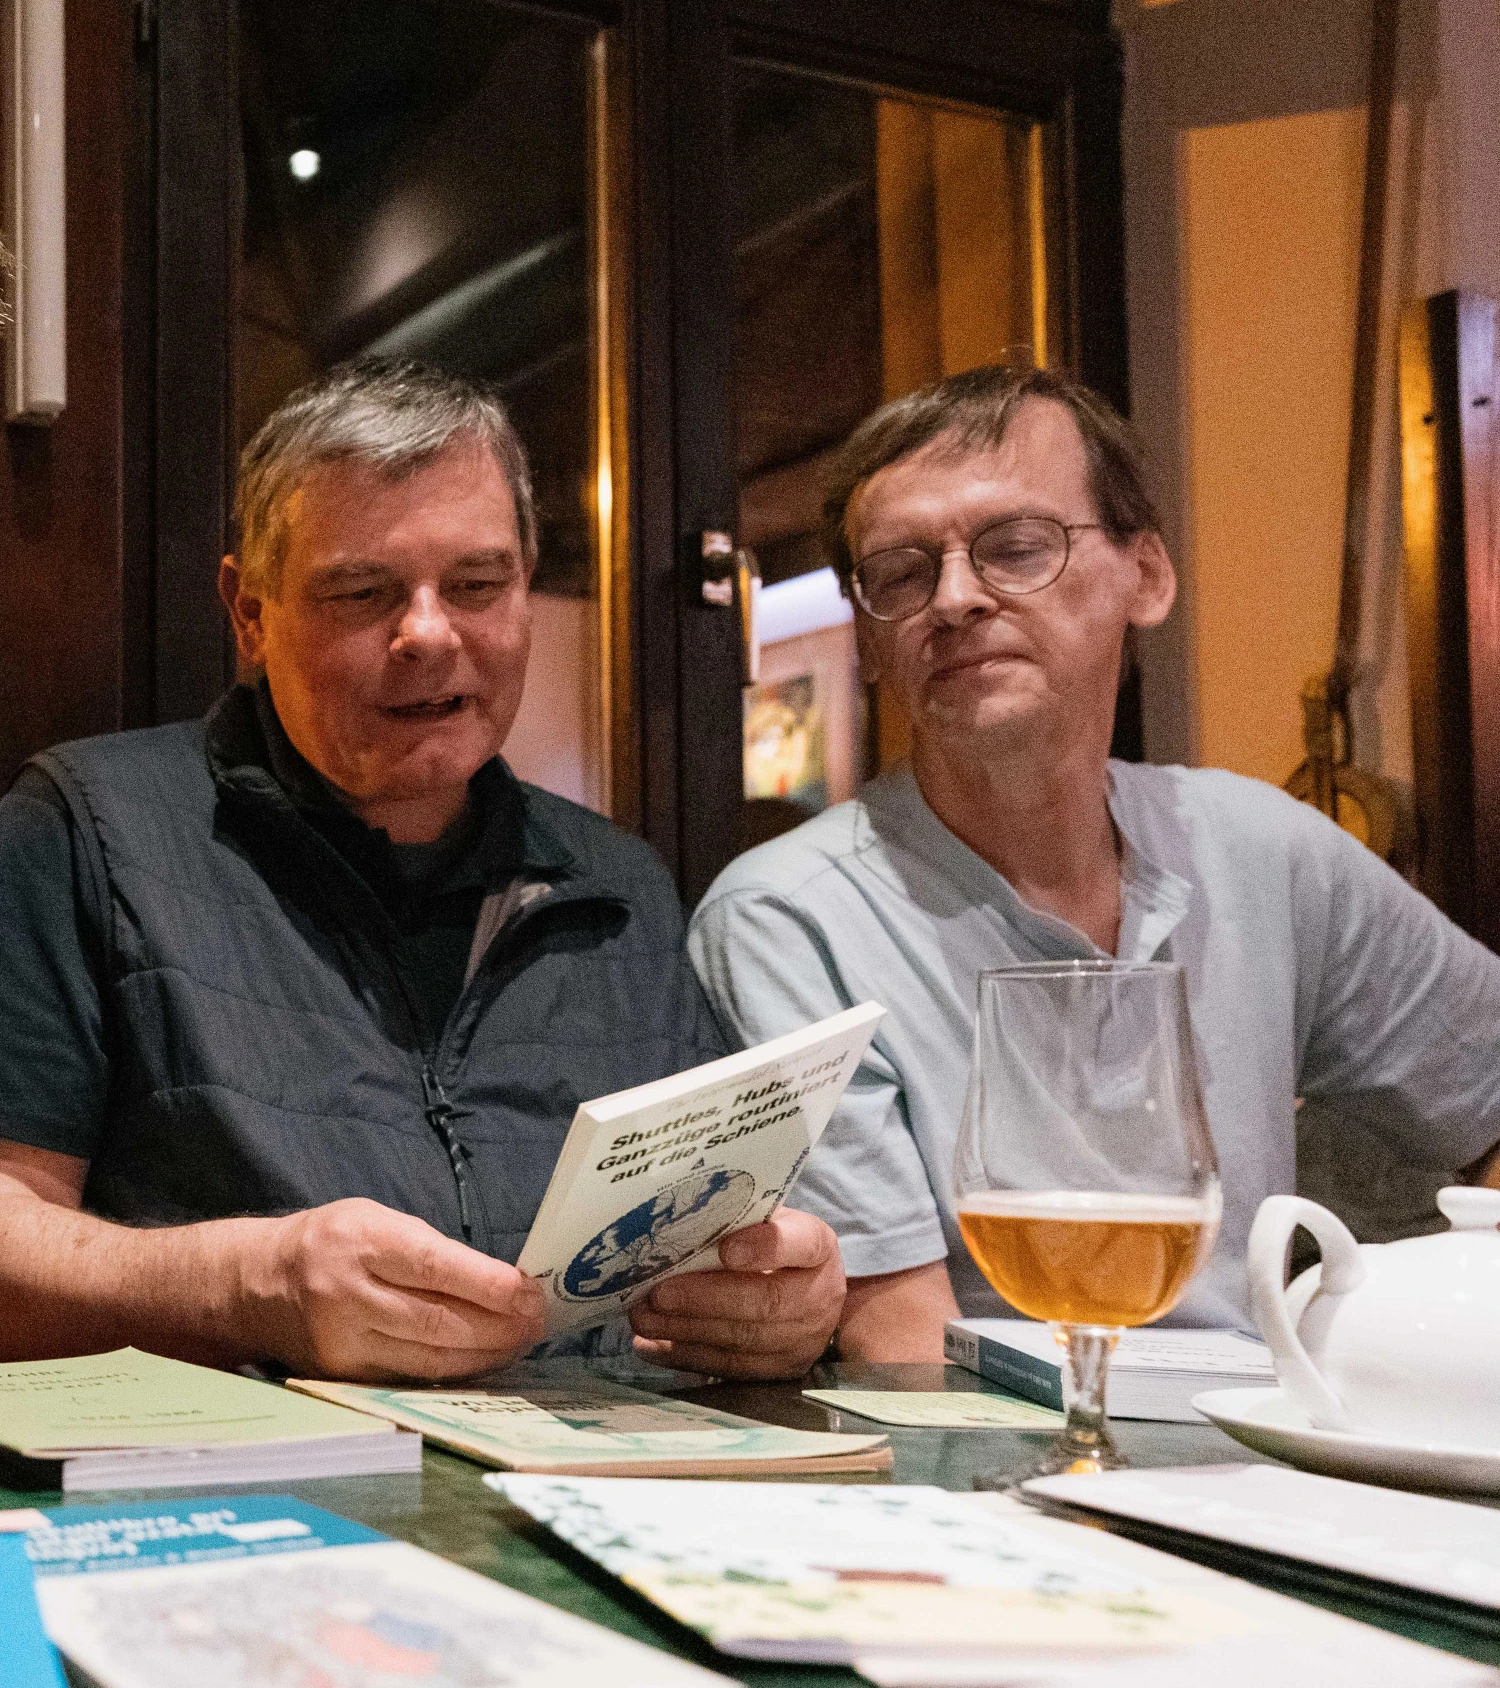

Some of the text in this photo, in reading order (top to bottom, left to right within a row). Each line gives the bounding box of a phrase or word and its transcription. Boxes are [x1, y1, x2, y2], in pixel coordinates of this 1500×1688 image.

[596, 1071, 841, 1172] Ganzzüge routiniert
[610, 1050, 850, 1151] Shuttles, Hubs und
[610, 1105, 804, 1184] auf die Schiene.
